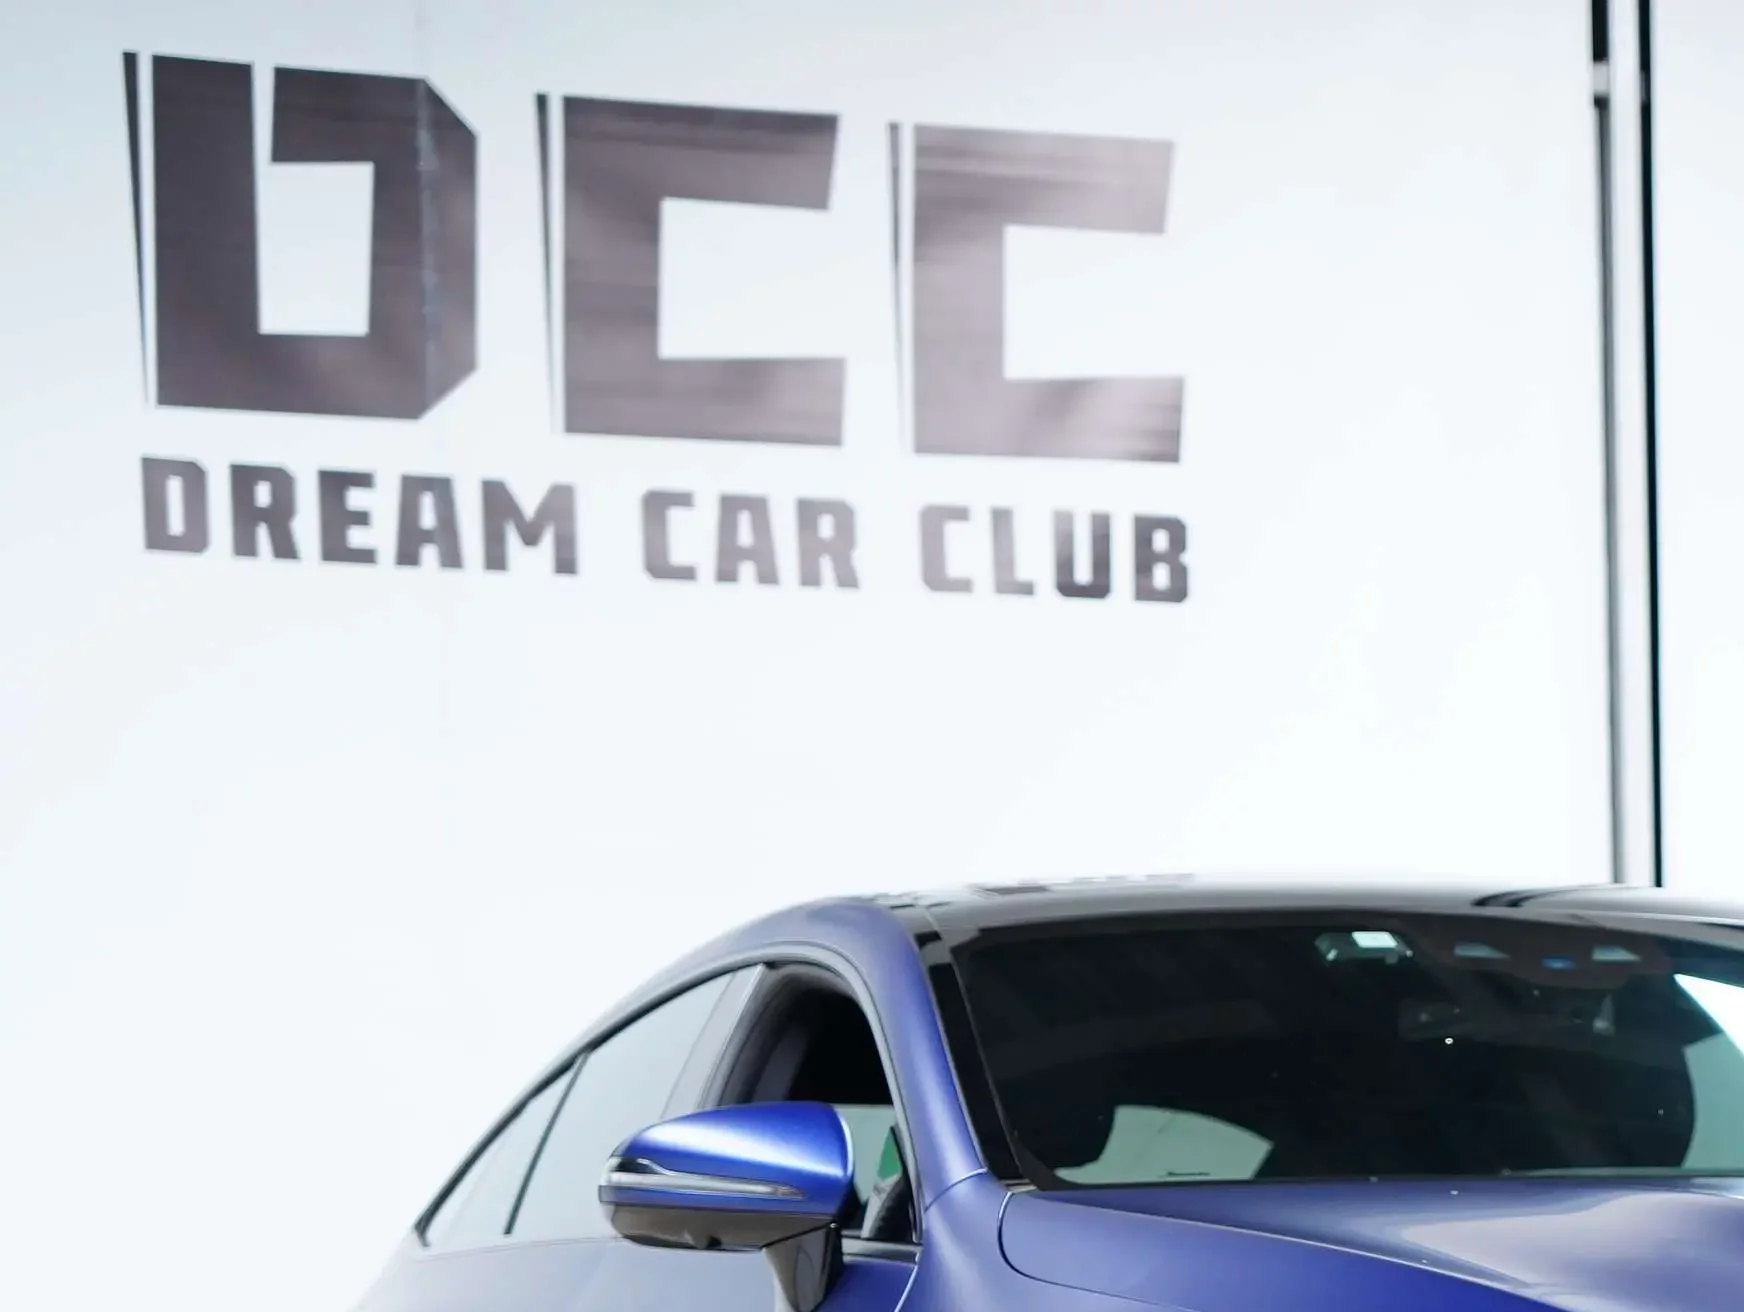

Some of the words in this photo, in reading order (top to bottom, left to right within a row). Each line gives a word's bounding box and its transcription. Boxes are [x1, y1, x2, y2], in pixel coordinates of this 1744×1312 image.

[122, 49, 1186, 463] DCC
[140, 454, 578, 576] DREAM
[640, 487, 860, 590] CAR
[918, 503, 1190, 604] CLUB
